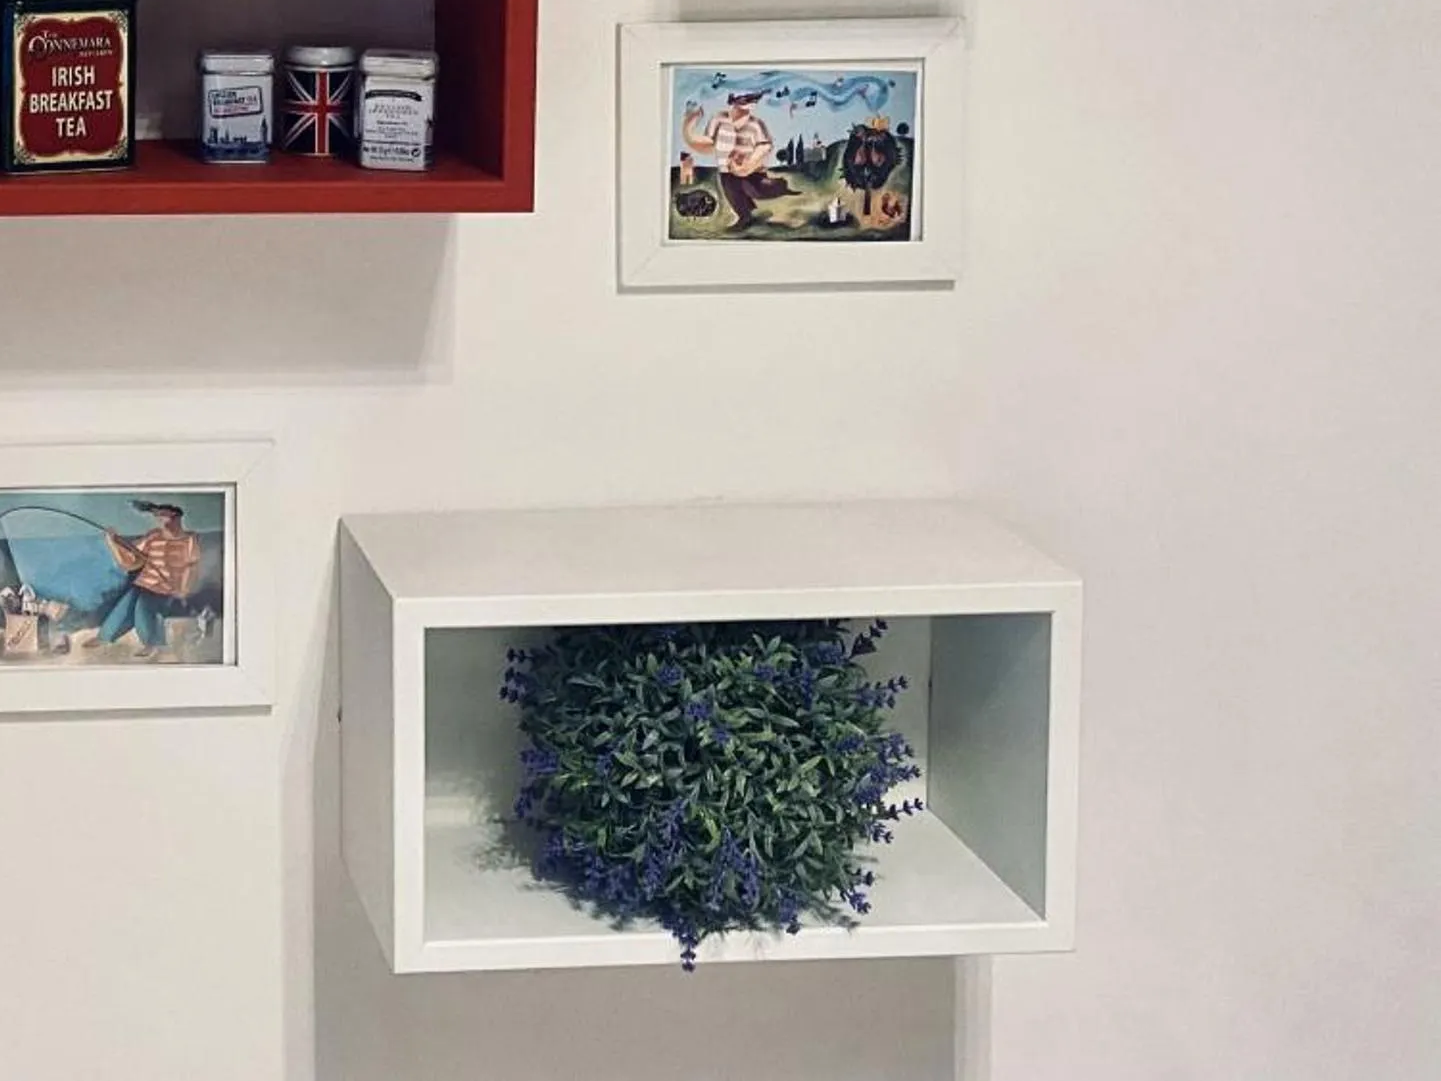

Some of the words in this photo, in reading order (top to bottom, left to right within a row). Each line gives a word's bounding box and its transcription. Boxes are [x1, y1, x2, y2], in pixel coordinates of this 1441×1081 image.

[51, 65, 96, 87] IRISH
[29, 89, 114, 114] BREAKFAST
[55, 116, 87, 138] TEA
